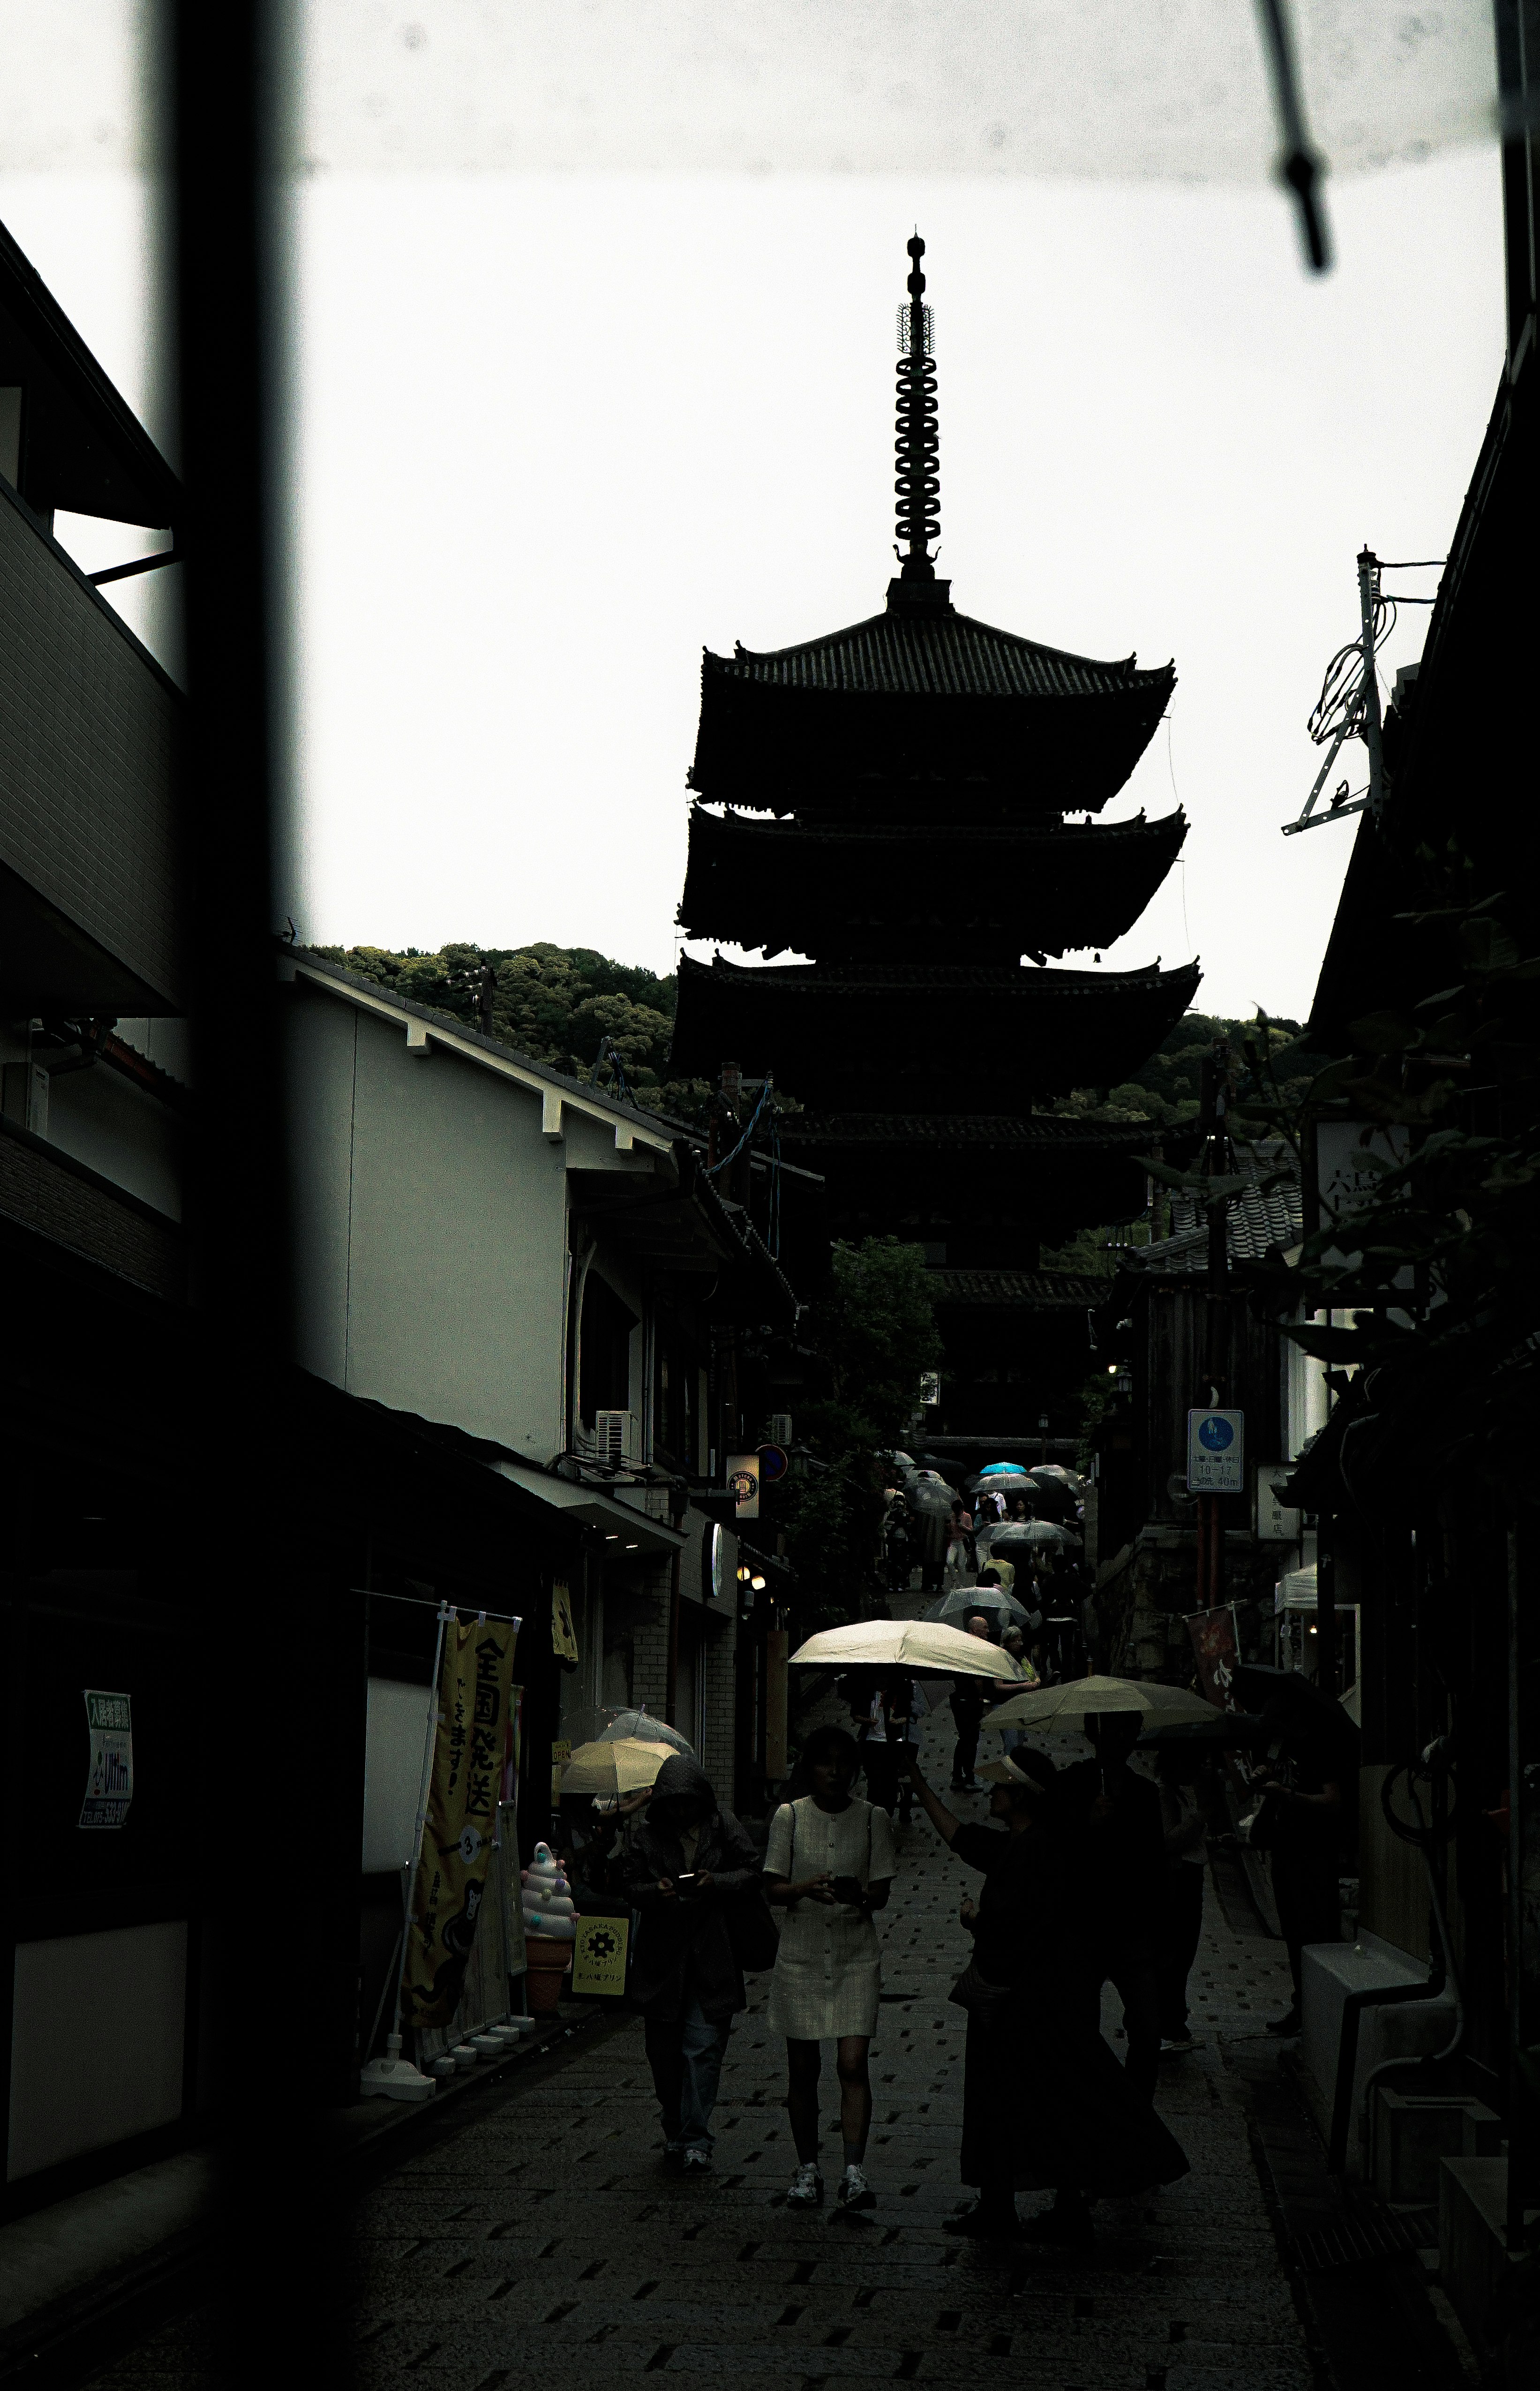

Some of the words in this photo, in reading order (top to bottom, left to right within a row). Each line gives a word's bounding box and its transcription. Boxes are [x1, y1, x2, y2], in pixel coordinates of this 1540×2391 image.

[90, 1698, 129, 1729] 入居者募集
[465, 1638, 505, 1817] 全国発送
[554, 1750, 571, 1759] OPEN
